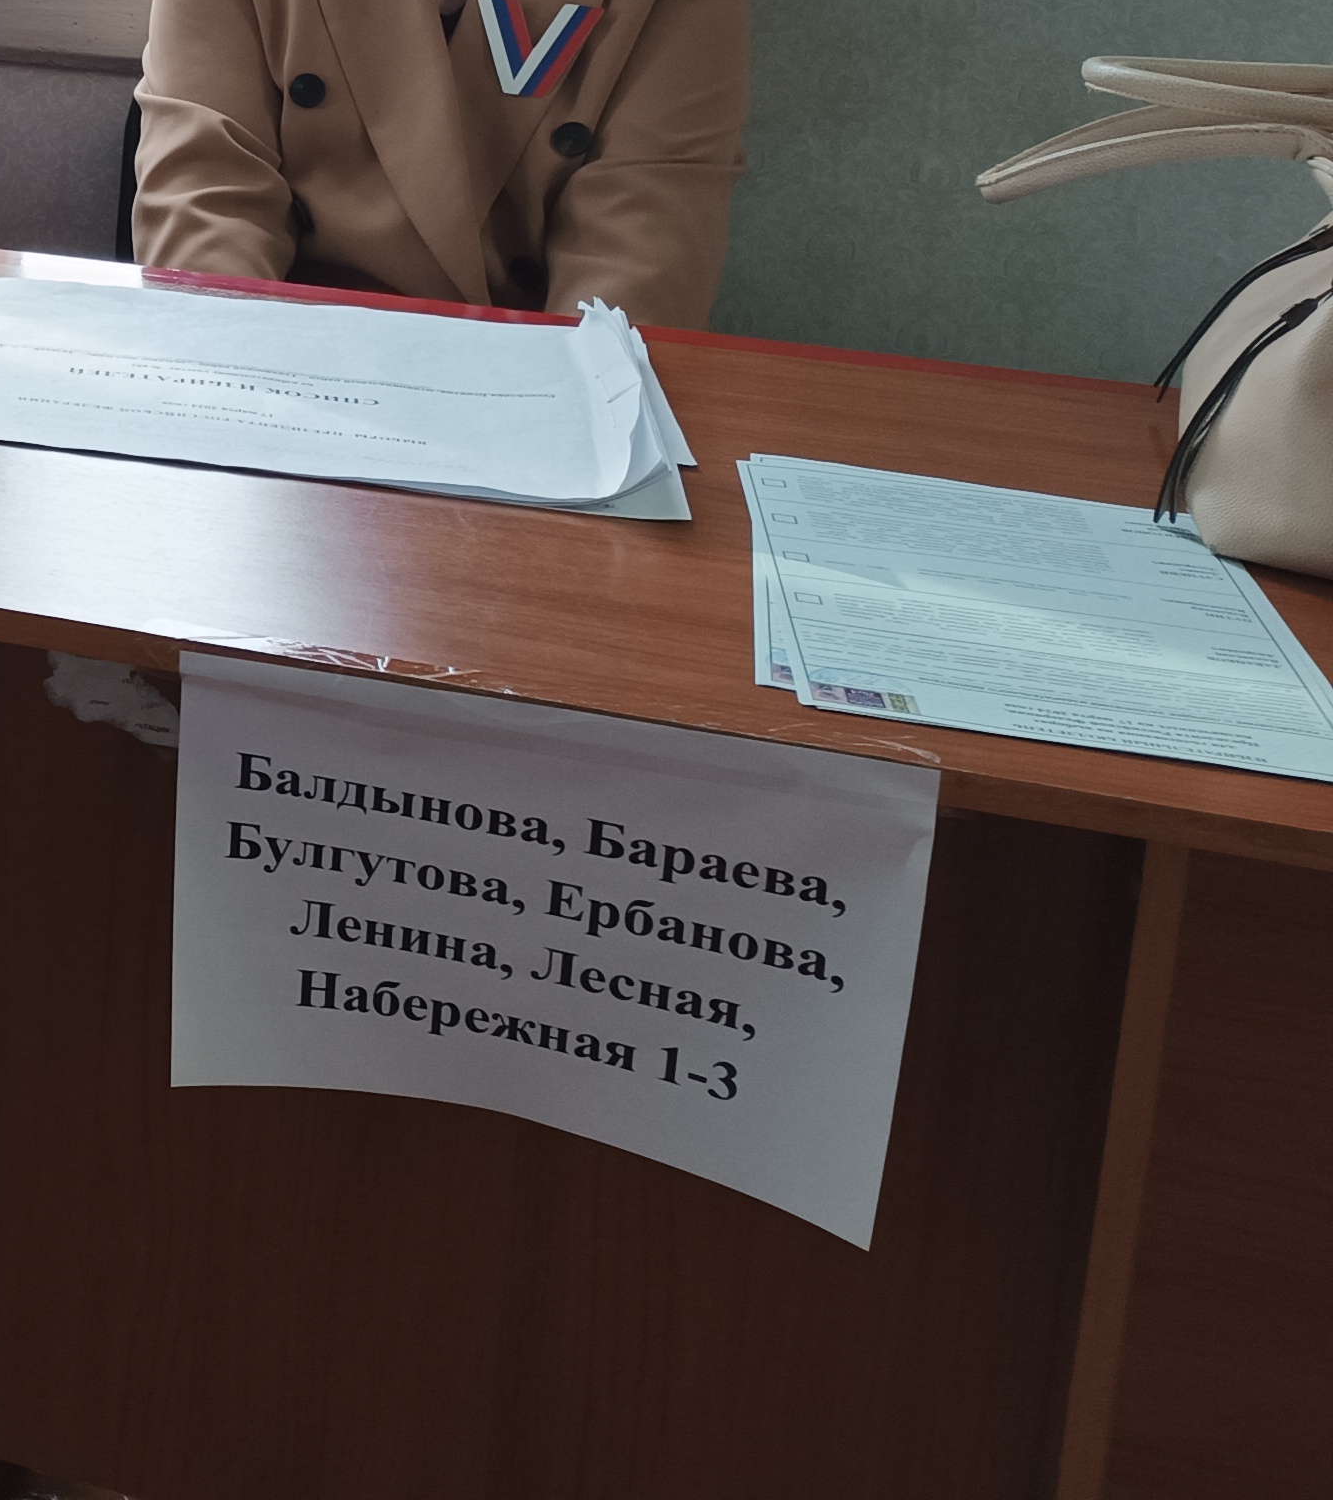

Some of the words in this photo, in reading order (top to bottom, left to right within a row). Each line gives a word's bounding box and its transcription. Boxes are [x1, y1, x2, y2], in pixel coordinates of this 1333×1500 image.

[68, 367, 254, 392] ИЗБИРАТЕЛЕЙ
[265, 386, 378, 406] СПИСОК
[235, 751, 566, 855] Балдынова,
[586, 817, 847, 918] Бараева,
[226, 821, 526, 916] Булгутова,
[548, 882, 846, 991] Ербанова,
[289, 899, 514, 979] Ленина,
[530, 948, 757, 1041] Лесная,
[295, 969, 635, 1071] Набережная
[660, 1044, 740, 1102] 1-3
